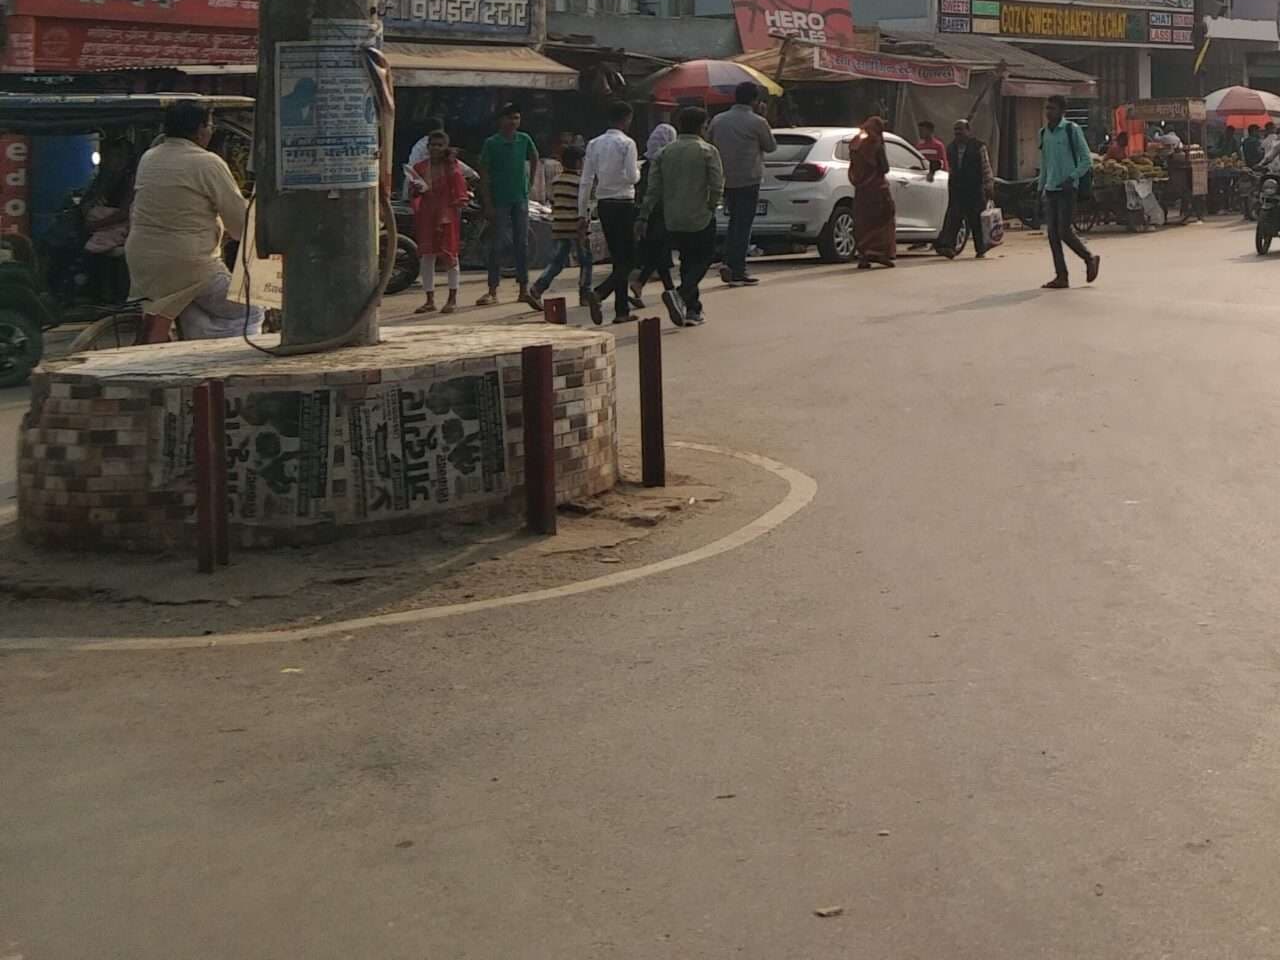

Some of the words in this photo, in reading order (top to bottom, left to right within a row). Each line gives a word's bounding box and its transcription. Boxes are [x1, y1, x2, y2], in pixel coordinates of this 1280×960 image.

[942, 0, 969, 13] SWEETS
[765, 10, 824, 30] HERO
[1001, 4, 1027, 33] COZY
[1027, 5, 1064, 36] SWEETS
[1064, 8, 1099, 38] BAKERY
[1106, 12, 1127, 39] CHAT
[1151, 13, 1170, 25] CHAT
